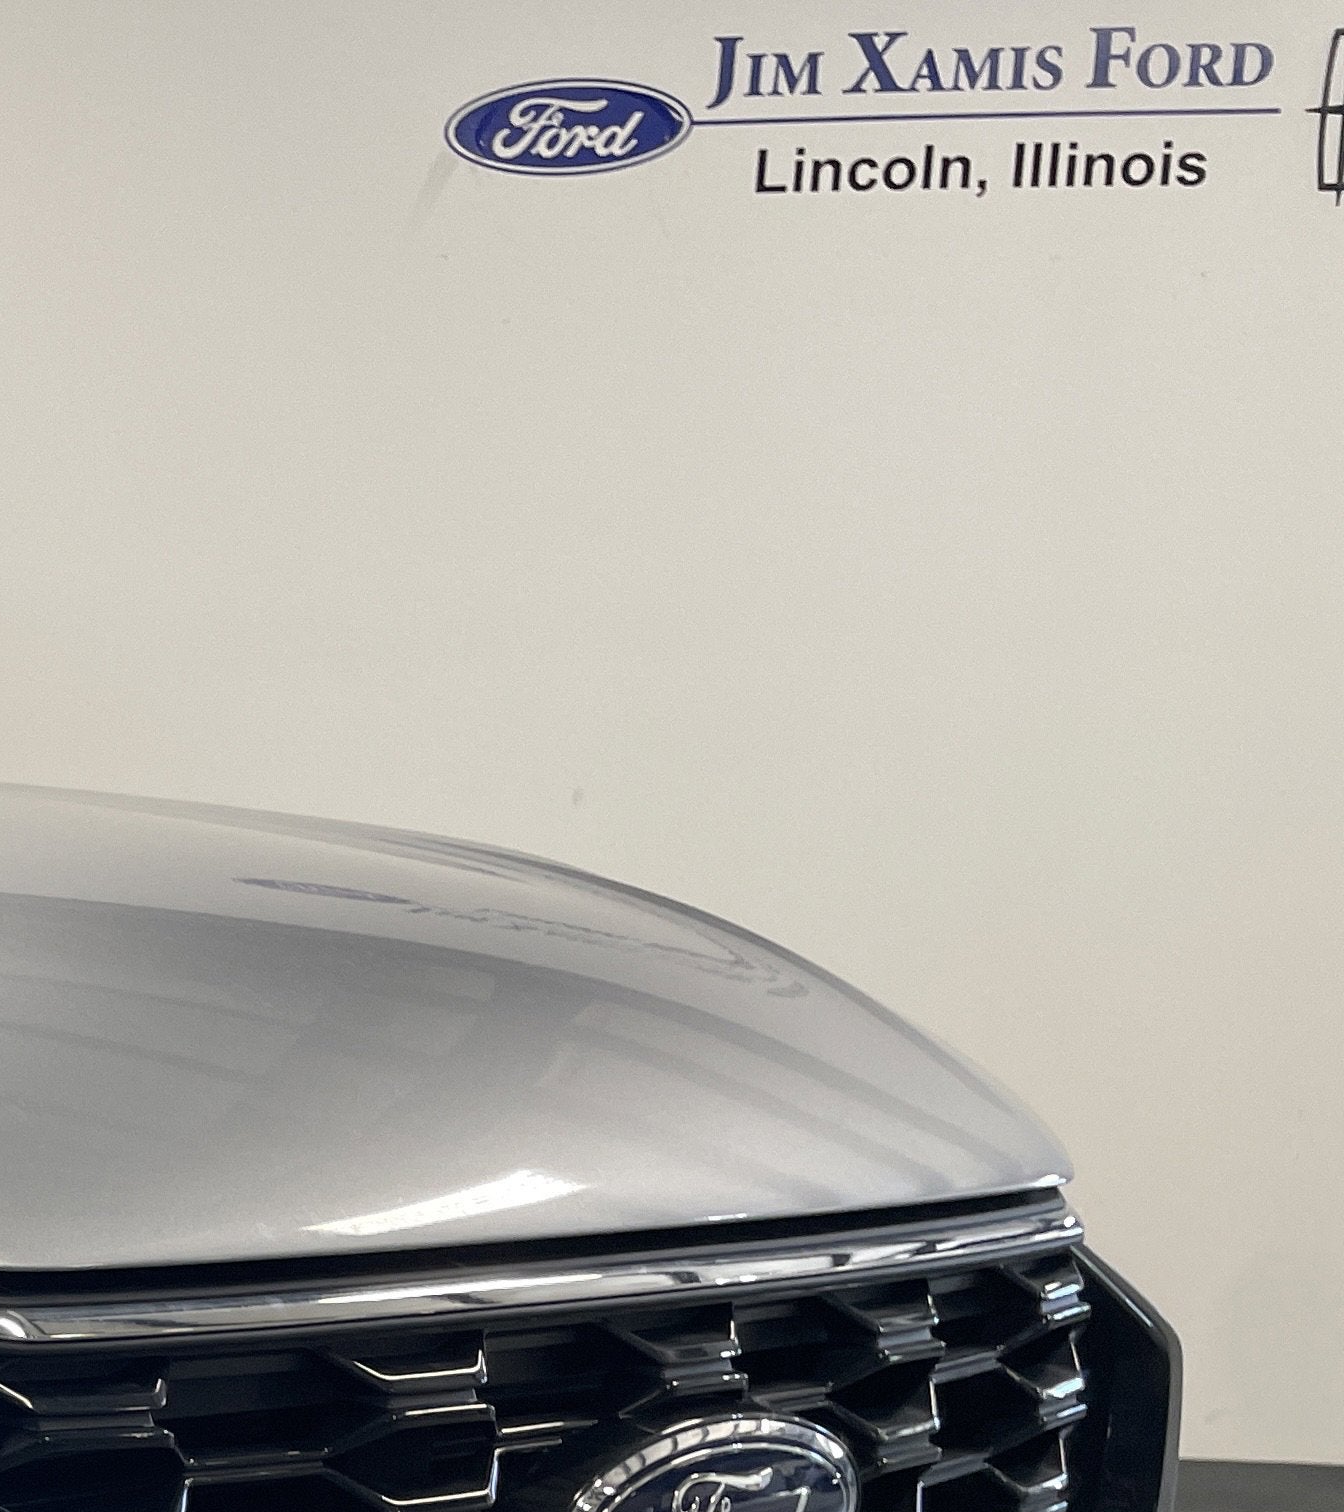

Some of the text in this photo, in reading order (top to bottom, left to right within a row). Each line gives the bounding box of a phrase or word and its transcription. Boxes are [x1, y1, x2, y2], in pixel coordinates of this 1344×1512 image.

[706, 26, 1274, 109] JIM XAMIS FORD
[492, 97, 645, 158] Ford
[755, 140, 1207, 197] Lincoln, Illinois
